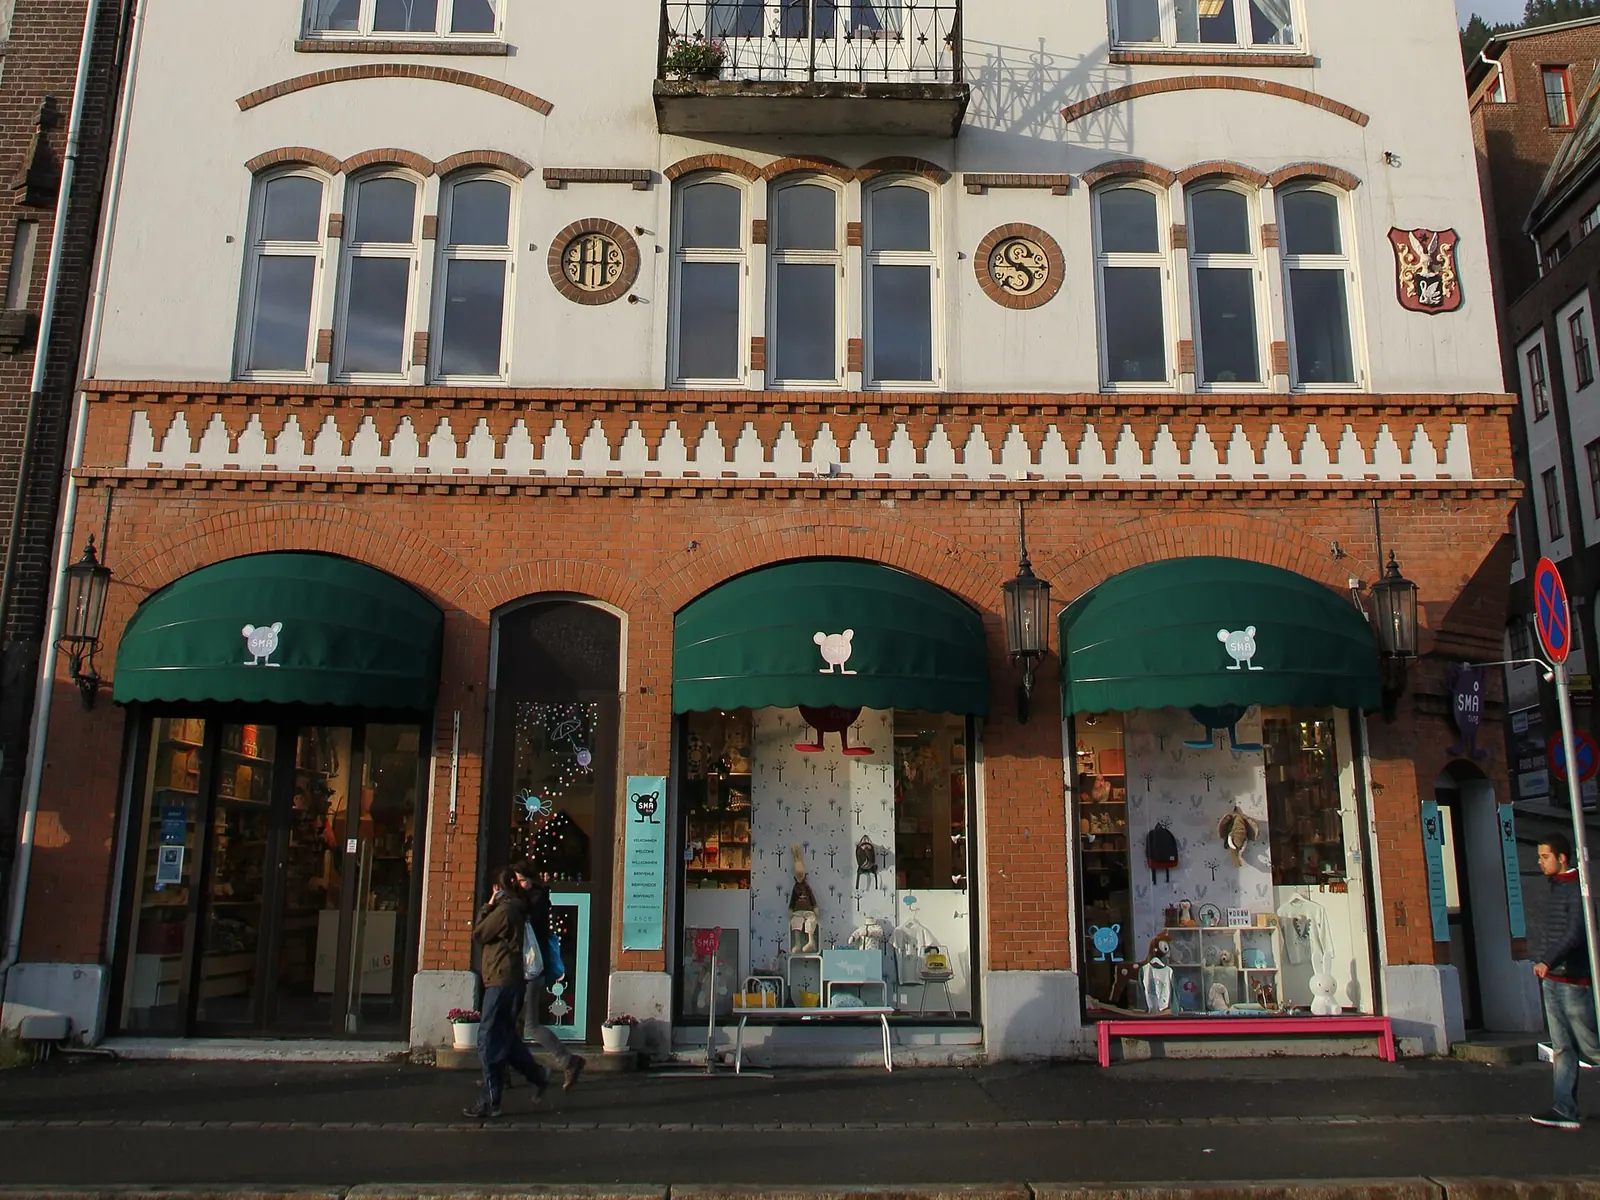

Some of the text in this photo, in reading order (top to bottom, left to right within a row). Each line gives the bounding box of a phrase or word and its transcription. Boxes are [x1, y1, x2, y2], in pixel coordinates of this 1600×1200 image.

[252, 632, 272, 648] SMÅ
[1230, 636, 1252, 652] SMÅ
[1457, 681, 1479, 712] SMÅ
[638, 798, 654, 809] SMÅ
[697, 933, 715, 947] SMÅ
